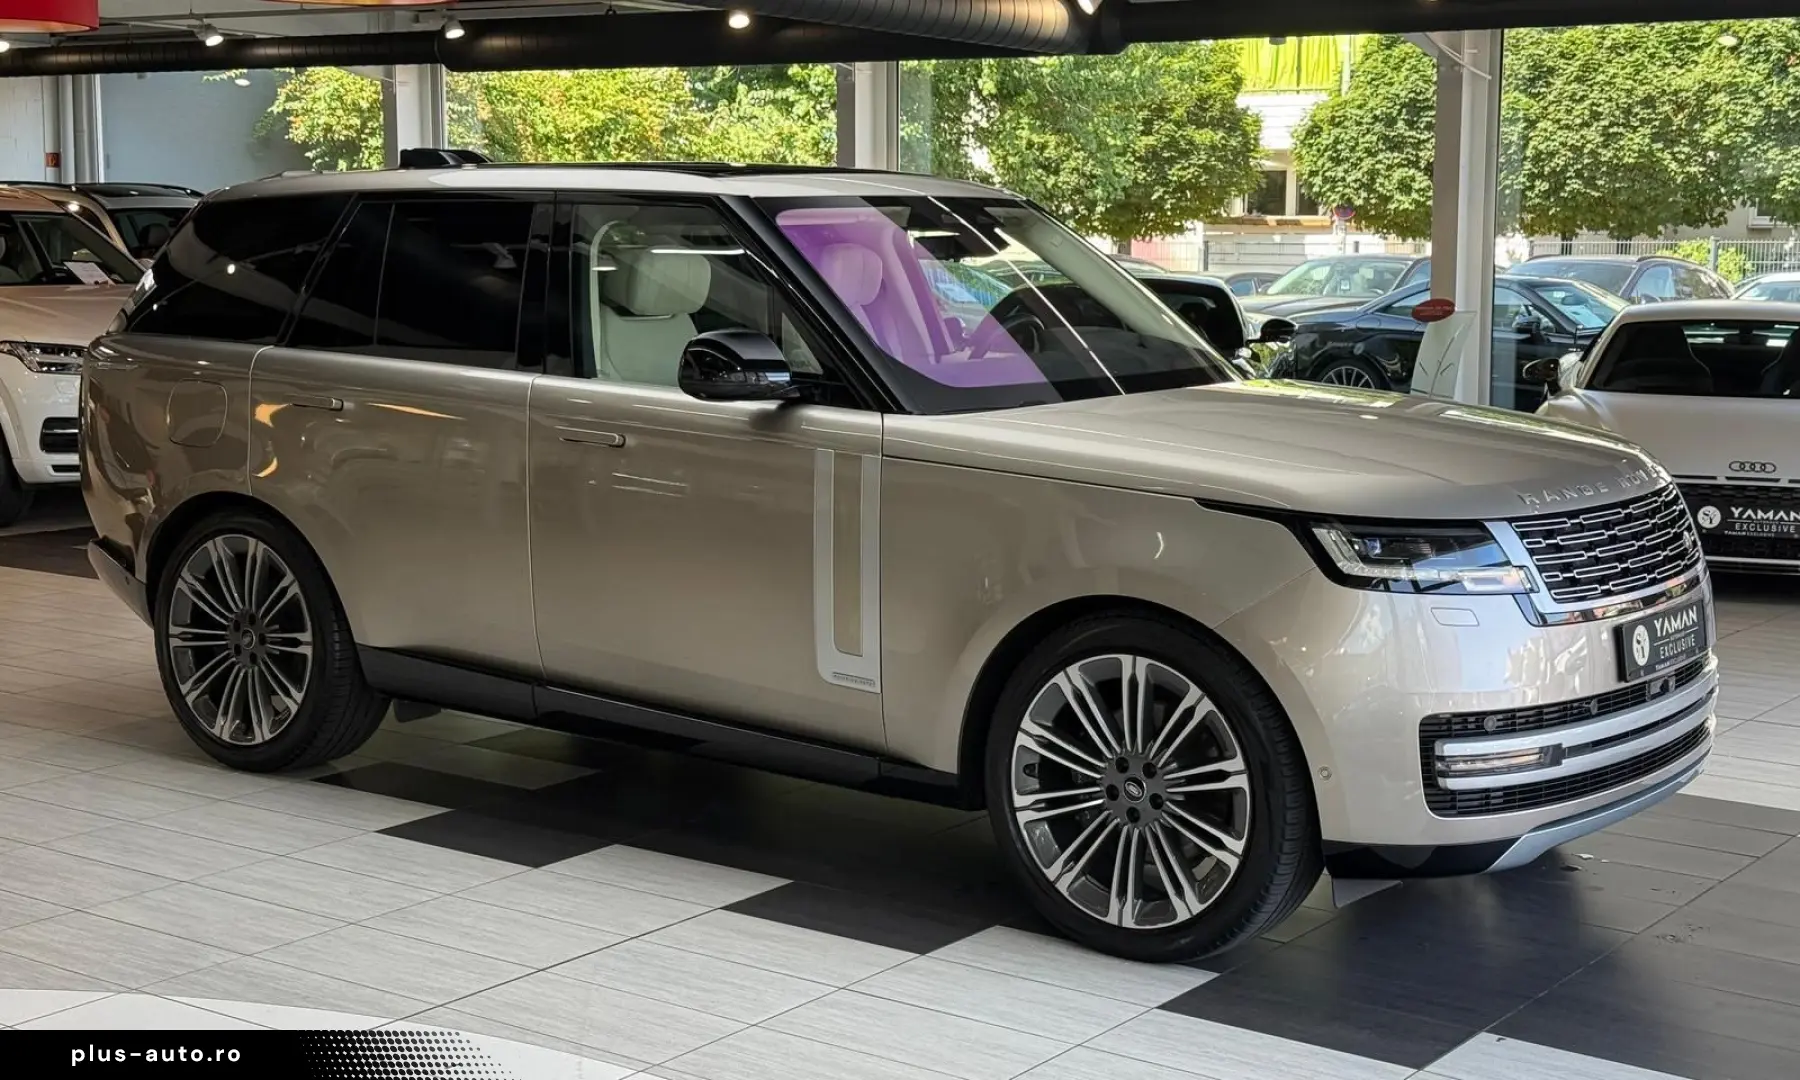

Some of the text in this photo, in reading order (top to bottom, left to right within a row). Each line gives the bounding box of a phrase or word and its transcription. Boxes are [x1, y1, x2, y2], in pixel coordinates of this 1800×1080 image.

[1517, 481, 1609, 505] RANGE
[1730, 506, 1800, 522] YAMAN
[1735, 522, 1796, 533] EXCLUSIVE
[1653, 605, 1698, 637] YAMAN
[1660, 633, 1696, 659] EXCLUSIVE
